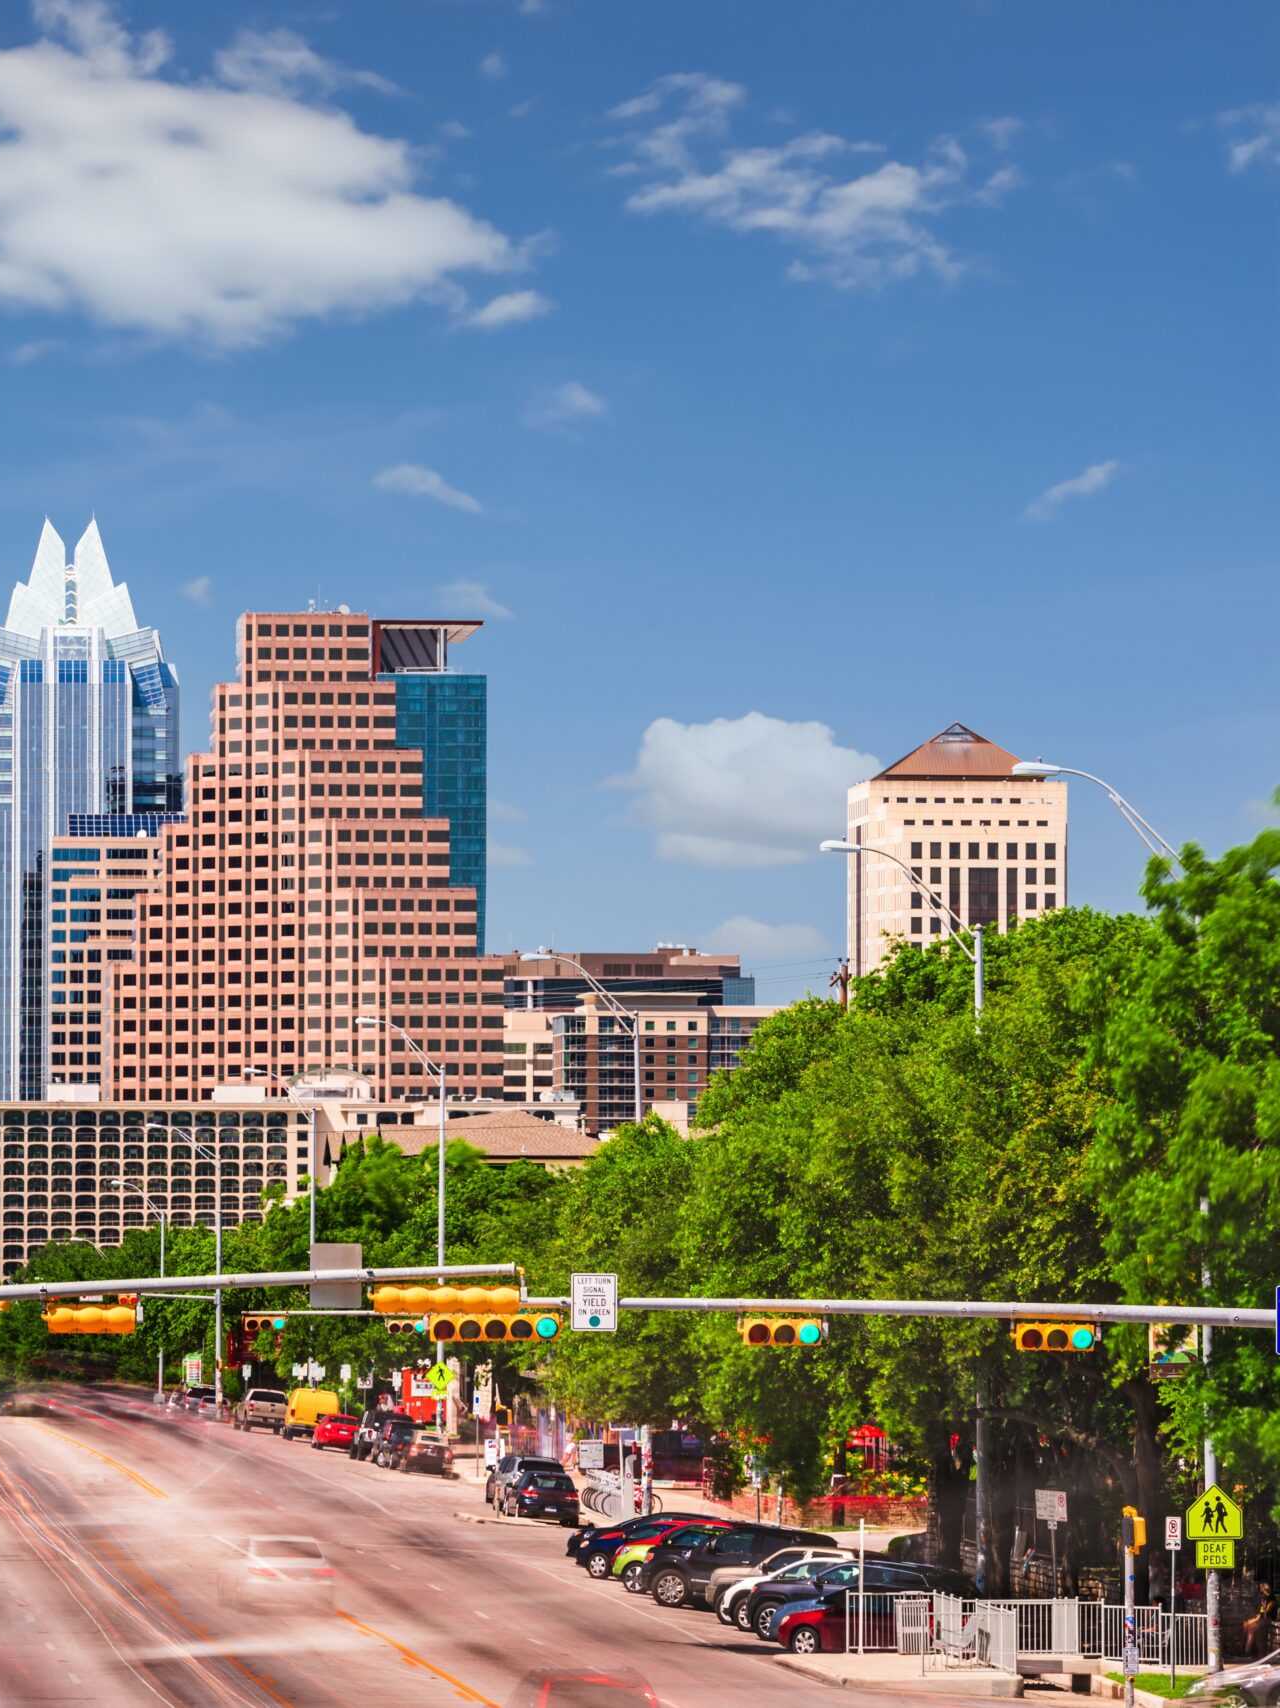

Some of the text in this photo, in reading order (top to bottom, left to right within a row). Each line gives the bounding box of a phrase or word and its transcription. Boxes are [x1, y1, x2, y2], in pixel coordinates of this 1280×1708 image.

[577, 1277, 611, 1285] LEFT TURN
[583, 1286, 605, 1294] SIGNAL
[582, 1298, 607, 1307] YIELD
[577, 1308, 611, 1316] ON GREEN
[1203, 1543, 1227, 1553] DEAF
[1203, 1555, 1227, 1565] PEDS
